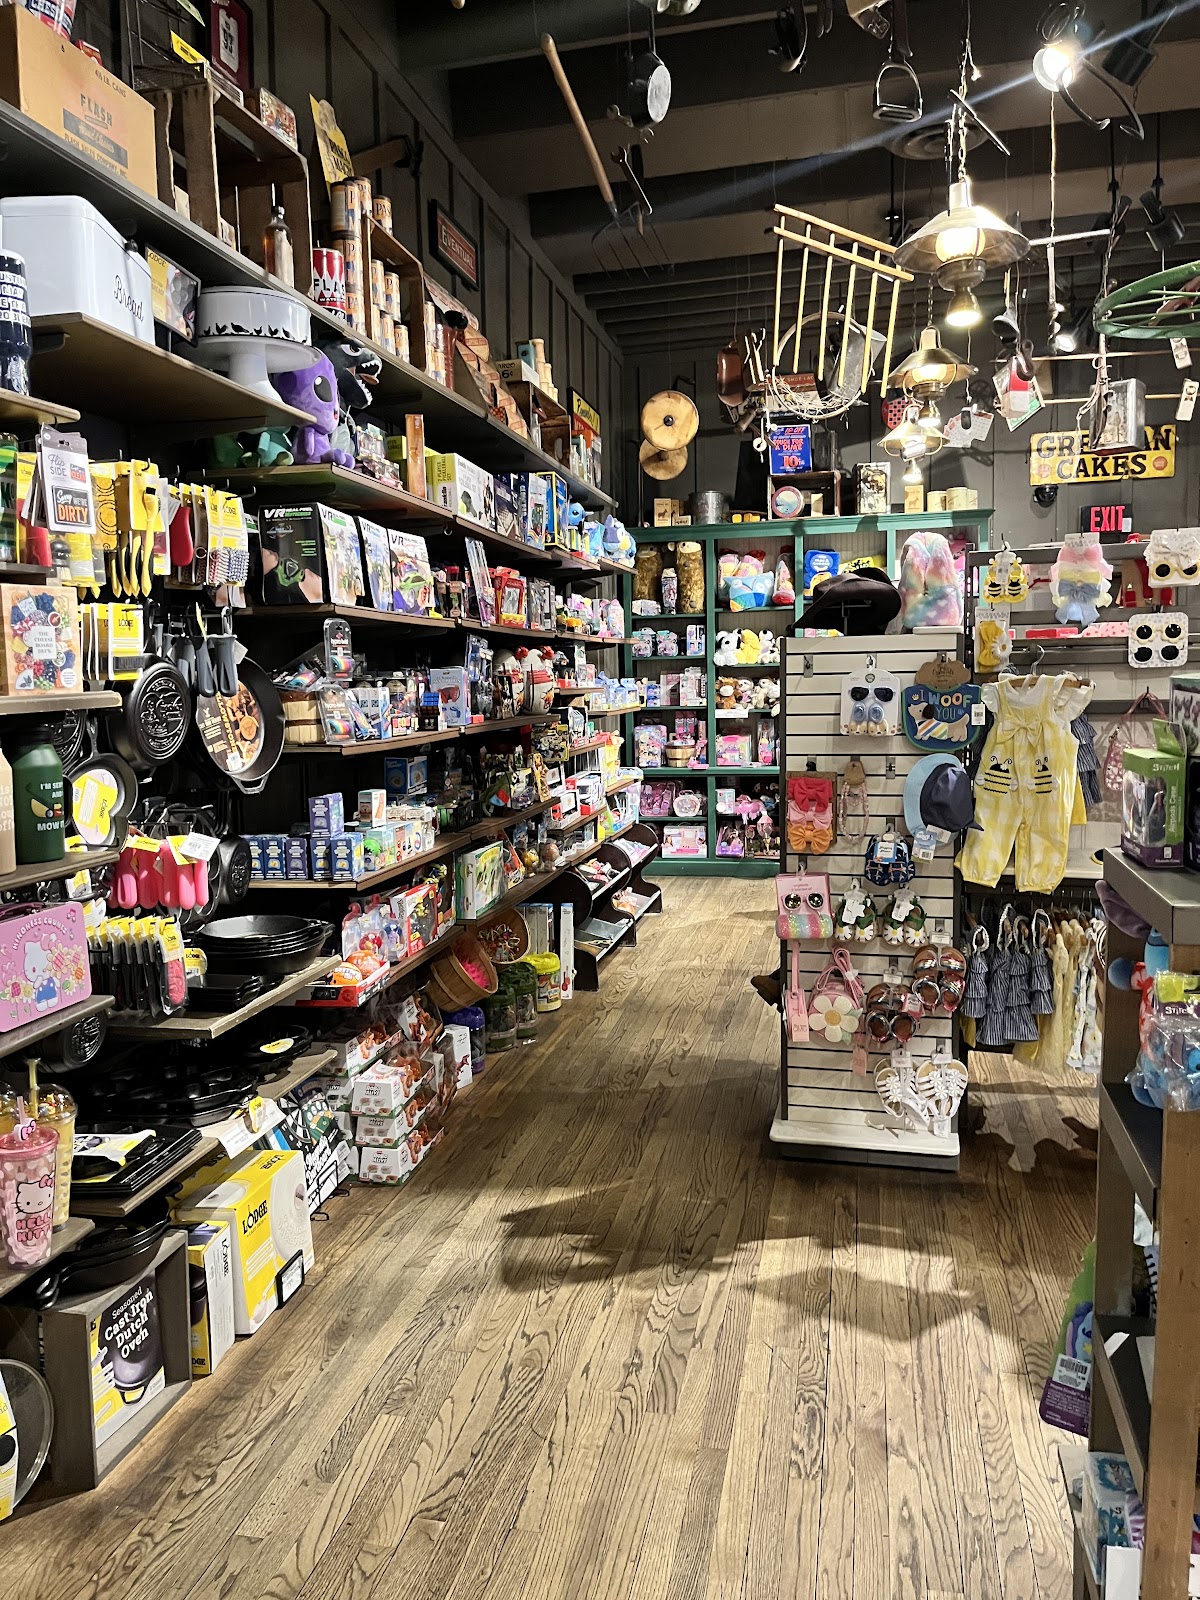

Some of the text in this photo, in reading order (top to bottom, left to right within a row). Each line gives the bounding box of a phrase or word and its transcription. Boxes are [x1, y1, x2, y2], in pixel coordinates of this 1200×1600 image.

[80, 93, 113, 127] FLASH
[442, 224, 475, 270] EVENTUAL
[114, 274, 144, 323] Bread
[49, 466, 67, 477] SIDE
[1056, 454, 1147, 479] CAKES
[56, 489, 73, 505] Sorry
[57, 504, 89, 524] DIRTY
[264, 508, 284, 519] VR
[321, 508, 335, 521] VR
[1090, 506, 1126, 531] EXIT
[361, 521, 374, 533] VR
[390, 535, 404, 546] VR
[928, 692, 973, 708] WOOF
[936, 707, 956, 720] YOU
[37, 820, 60, 831] MOW
[11, 916, 68, 951] KINDNESS COUNTS
[1165, 1006, 1188, 1015] STITC
[16, 1212, 51, 1230] HELL
[242, 1200, 268, 1235] LODGE
[16, 1223, 51, 1242] KITT
[221, 1238, 230, 1277] LODGE
[111, 1286, 143, 1319] Seasoned
[104, 1312, 130, 1341] Cast
[130, 1290, 155, 1318] Iron
[116, 1311, 149, 1349] Dutch
[121, 1327, 150, 1359] Oven
[191, 1357, 206, 1366] DGE
